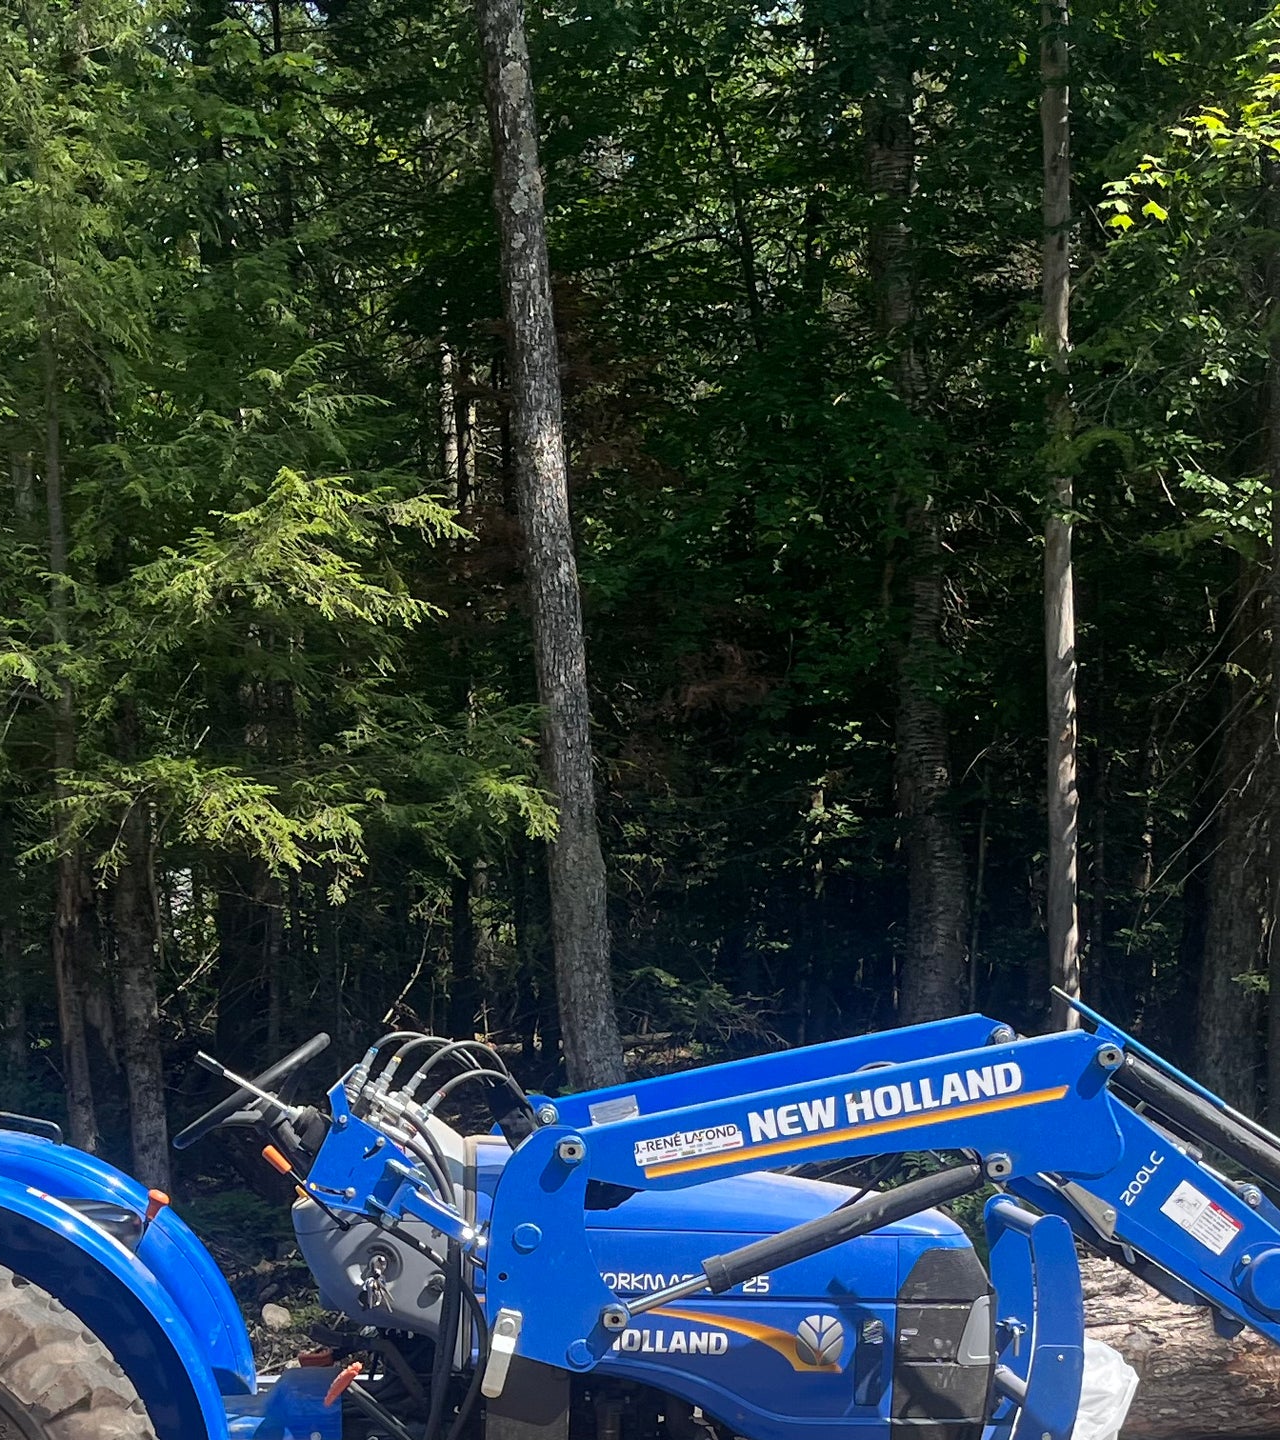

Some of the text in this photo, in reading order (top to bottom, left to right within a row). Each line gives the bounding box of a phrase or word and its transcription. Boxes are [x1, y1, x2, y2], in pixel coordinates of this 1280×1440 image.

[747, 1061, 1023, 1143] NEW HOLLAND
[1119, 1150, 1166, 1207] 200LC
[742, 1275, 770, 1293] 25
